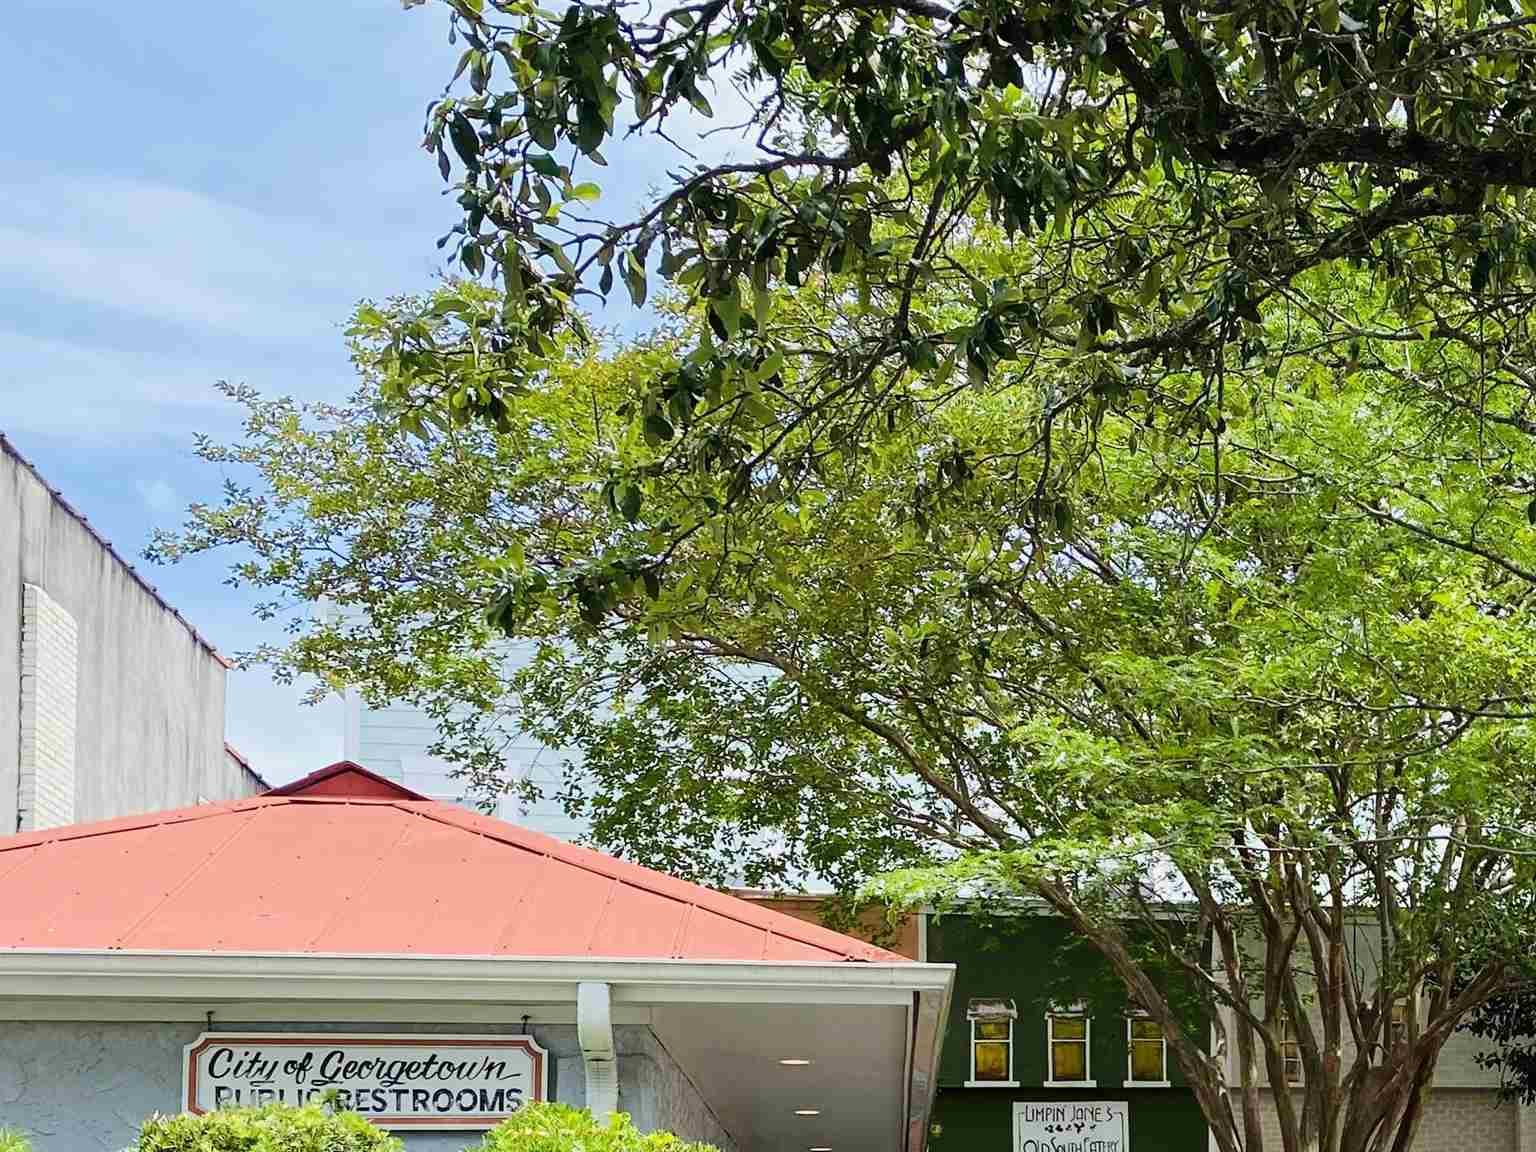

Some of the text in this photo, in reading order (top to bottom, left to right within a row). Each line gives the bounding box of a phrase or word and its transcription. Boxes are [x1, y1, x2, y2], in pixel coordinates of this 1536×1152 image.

[208, 1048, 521, 1087] City of Georgetown
[335, 1087, 523, 1112] RESTROOMS
